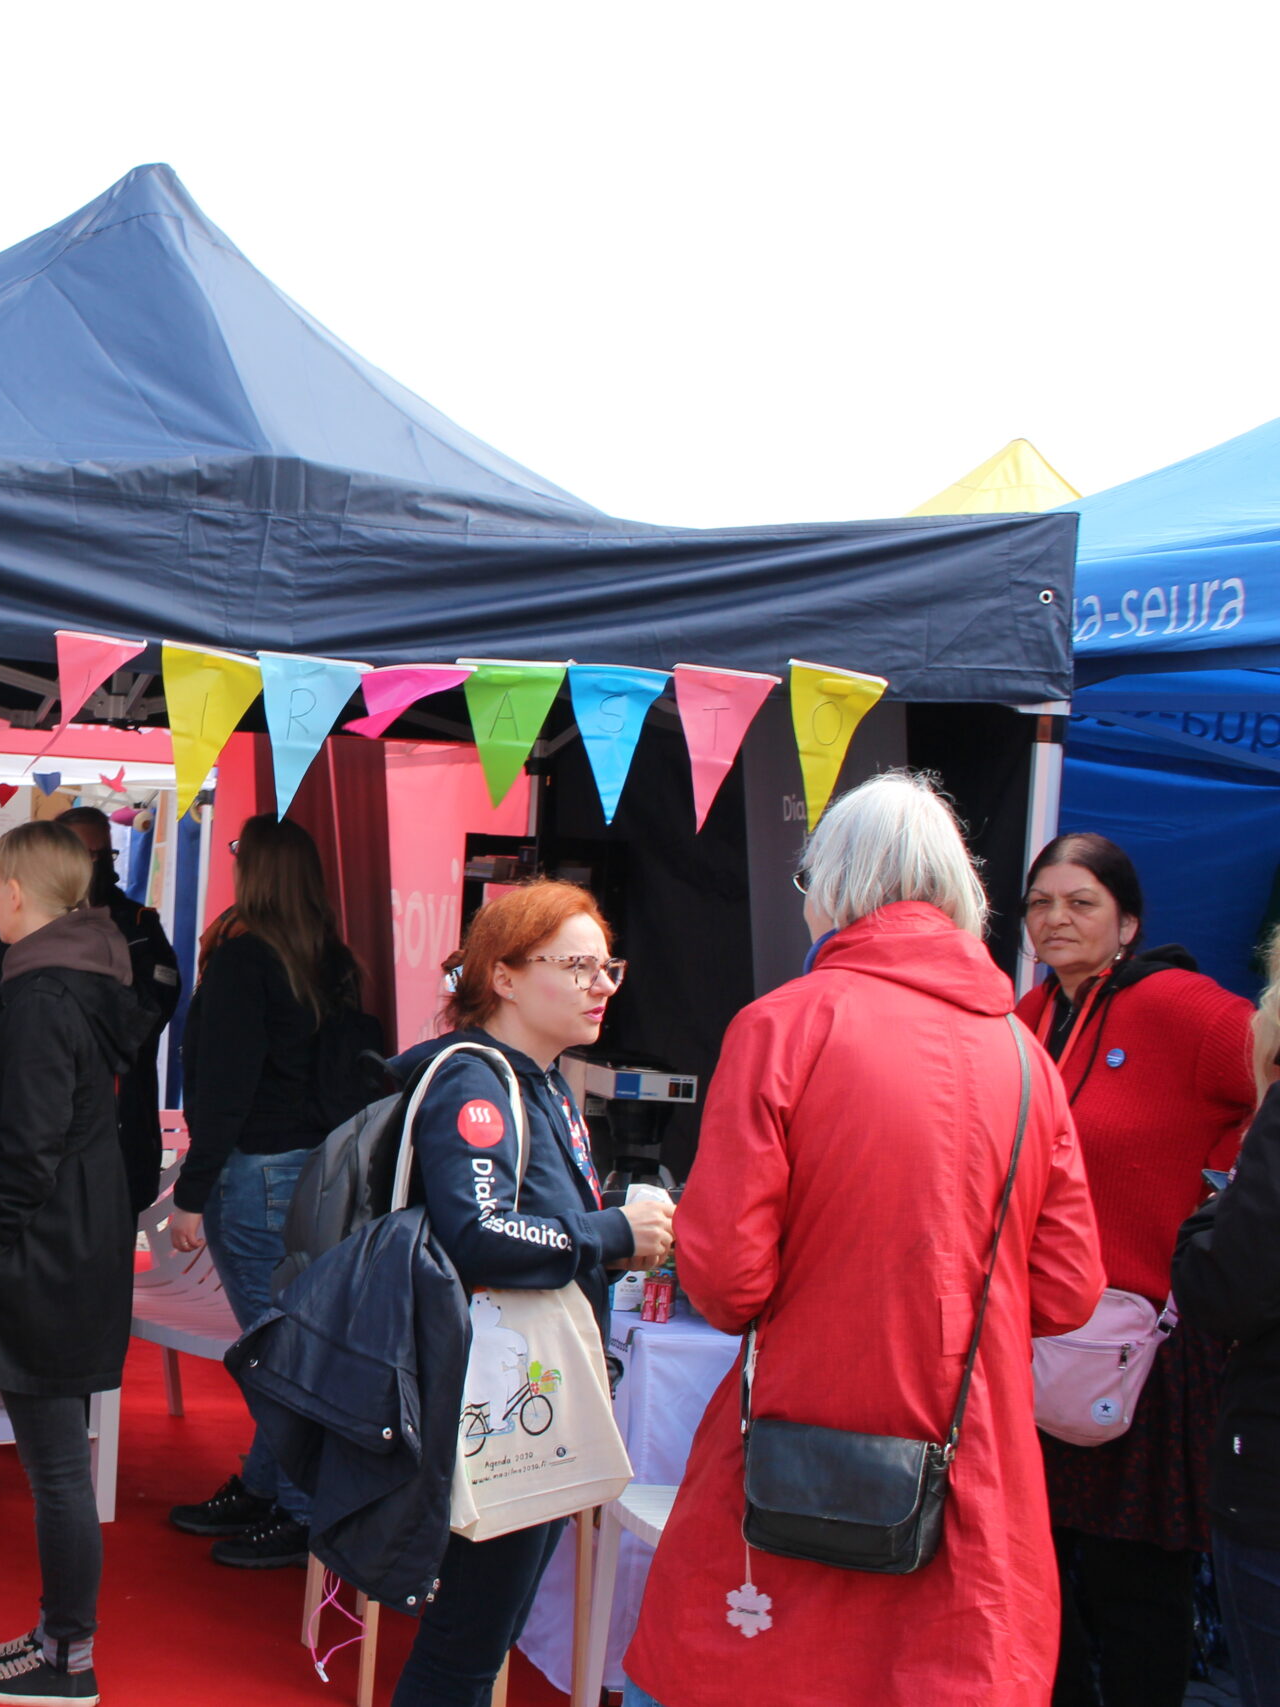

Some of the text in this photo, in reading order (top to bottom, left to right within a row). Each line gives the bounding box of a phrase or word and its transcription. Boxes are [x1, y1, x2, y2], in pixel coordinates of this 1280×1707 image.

[783, 793, 807, 821] Dia
[484, 1455, 511, 1471] Agenda
[515, 1451, 534, 1462] 2030
